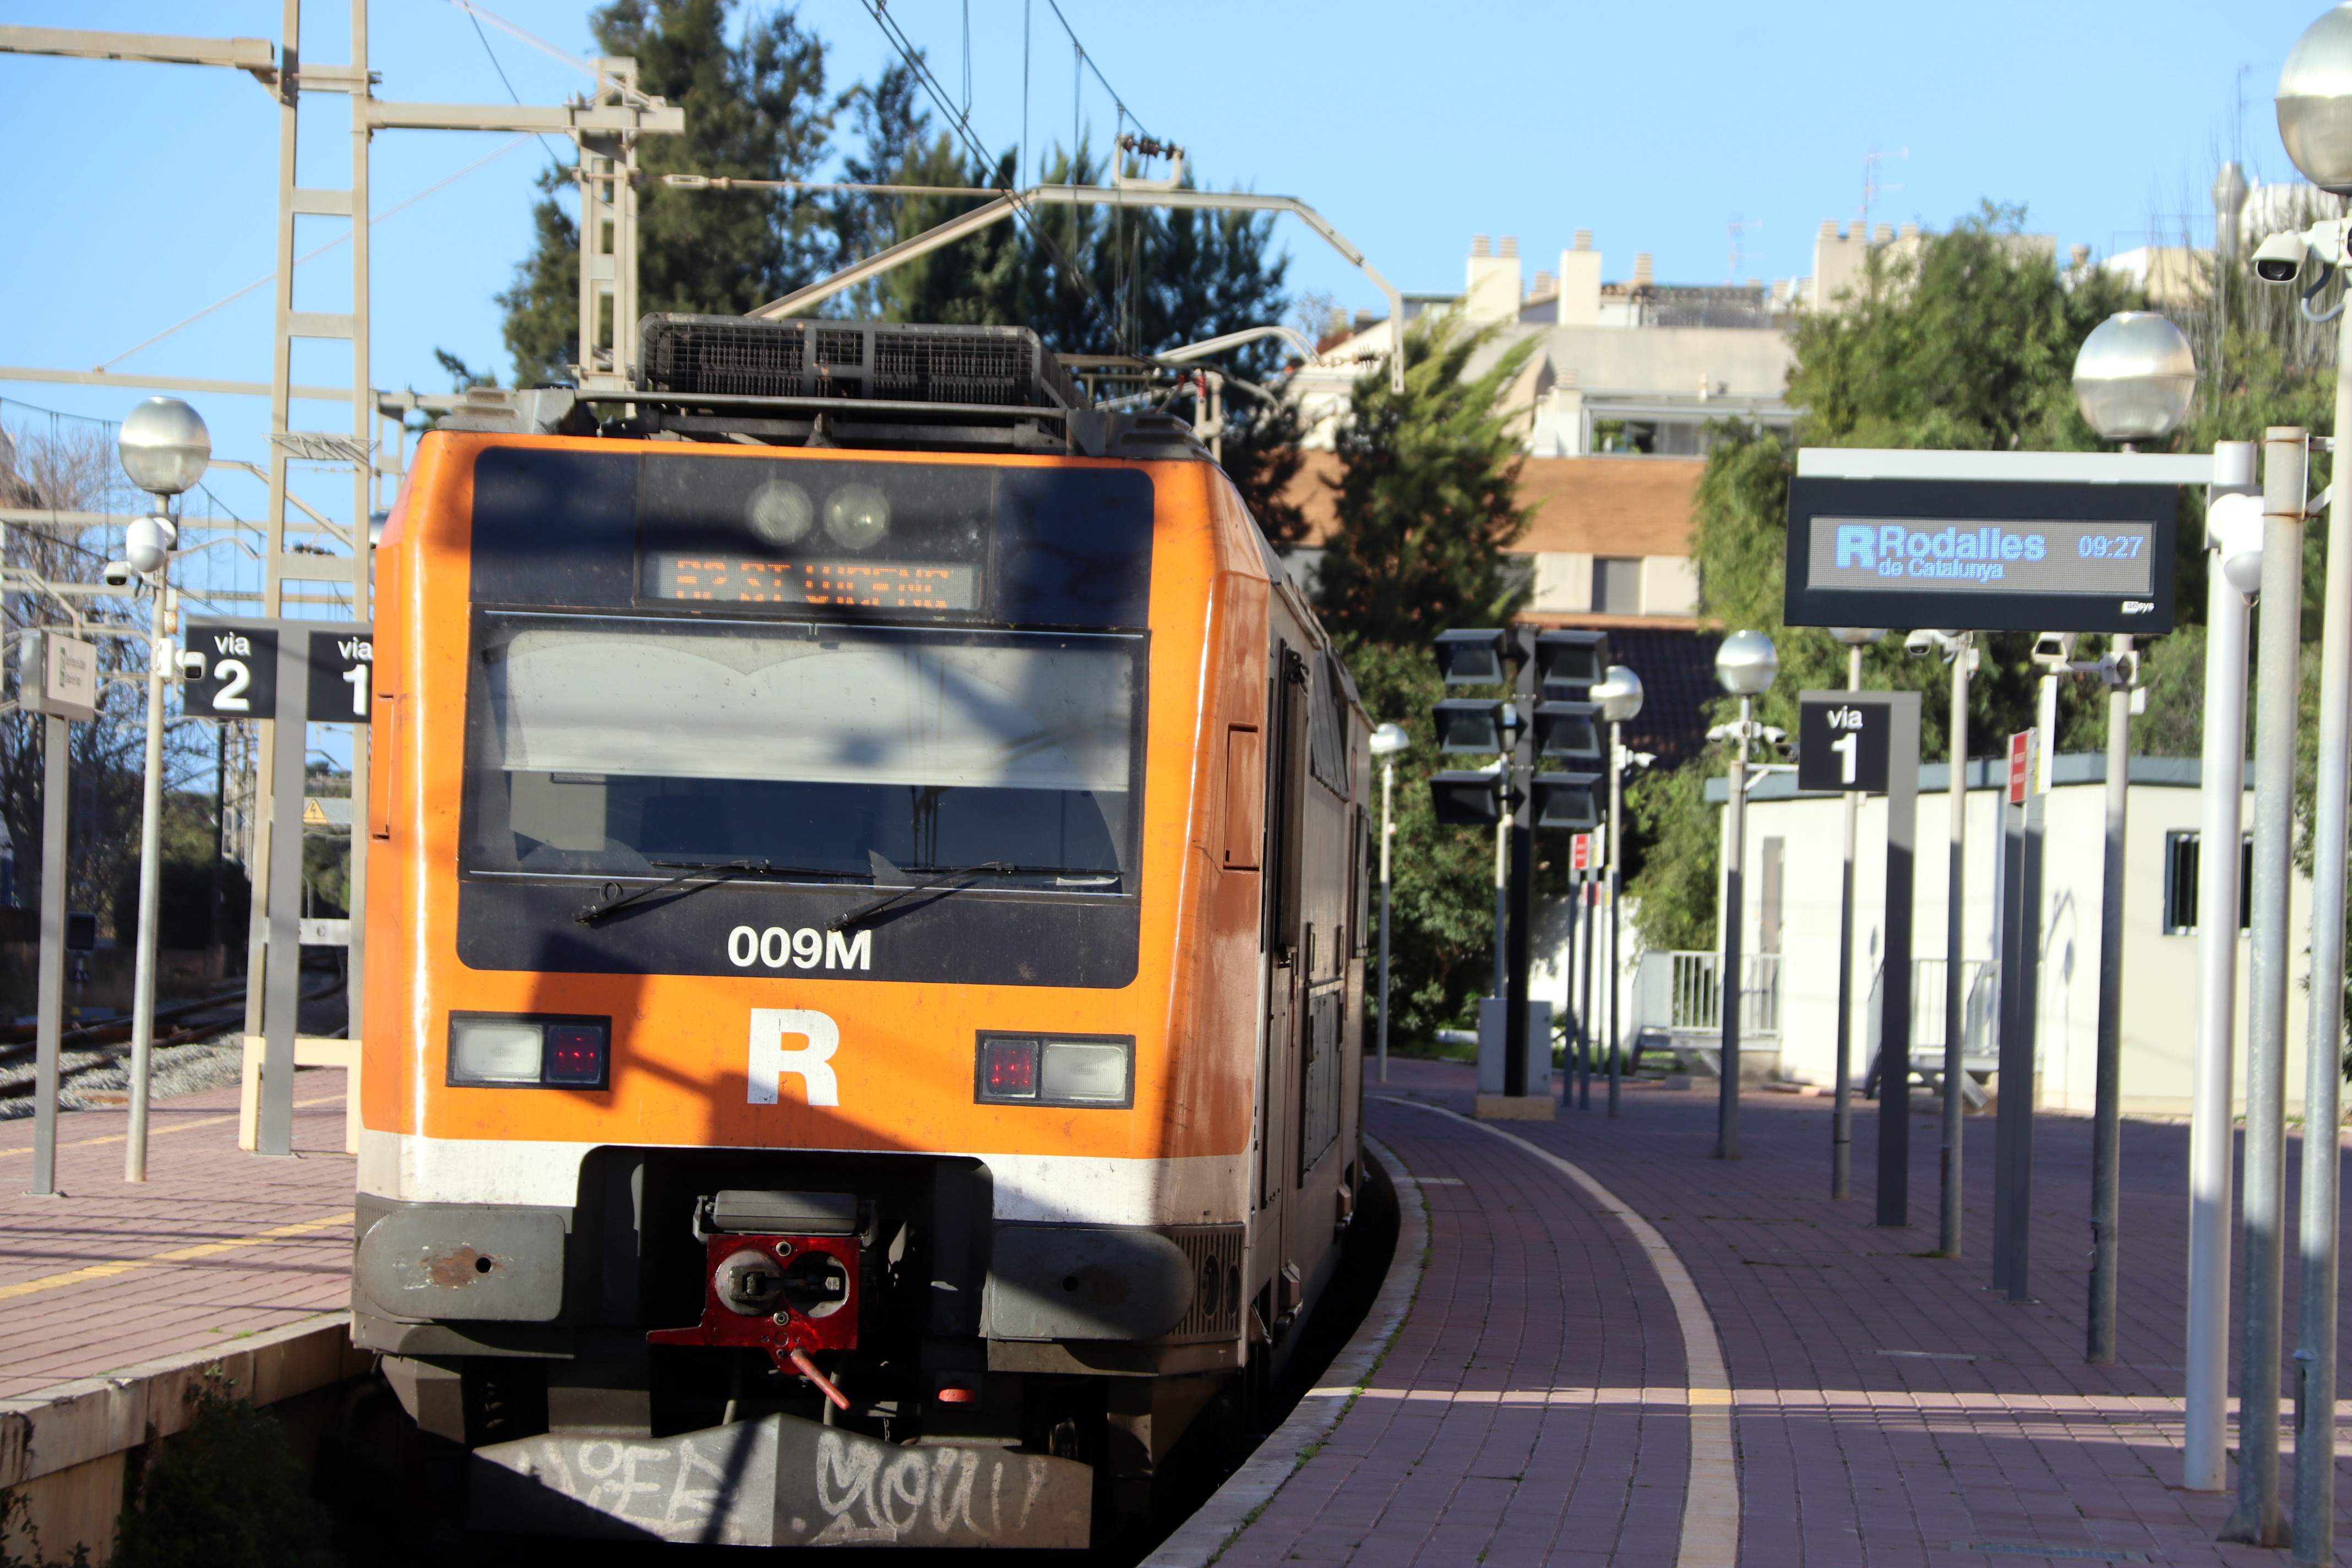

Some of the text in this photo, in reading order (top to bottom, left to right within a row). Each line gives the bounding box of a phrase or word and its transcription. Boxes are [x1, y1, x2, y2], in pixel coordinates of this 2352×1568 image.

[1878, 525, 2048, 562] Rodalles
[2078, 535, 2144, 559] 09:27
[1877, 558, 2005, 584] de Catalunya
[2123, 601, 2155, 615] aesys
[214, 631, 251, 656] via
[337, 636, 372, 660] via
[213, 659, 250, 711] 2
[342, 664, 368, 716] 1
[1827, 705, 1863, 729] via
[1832, 732, 1857, 784] 1
[728, 925, 872, 970] 009M
[747, 1008, 840, 1108] R
